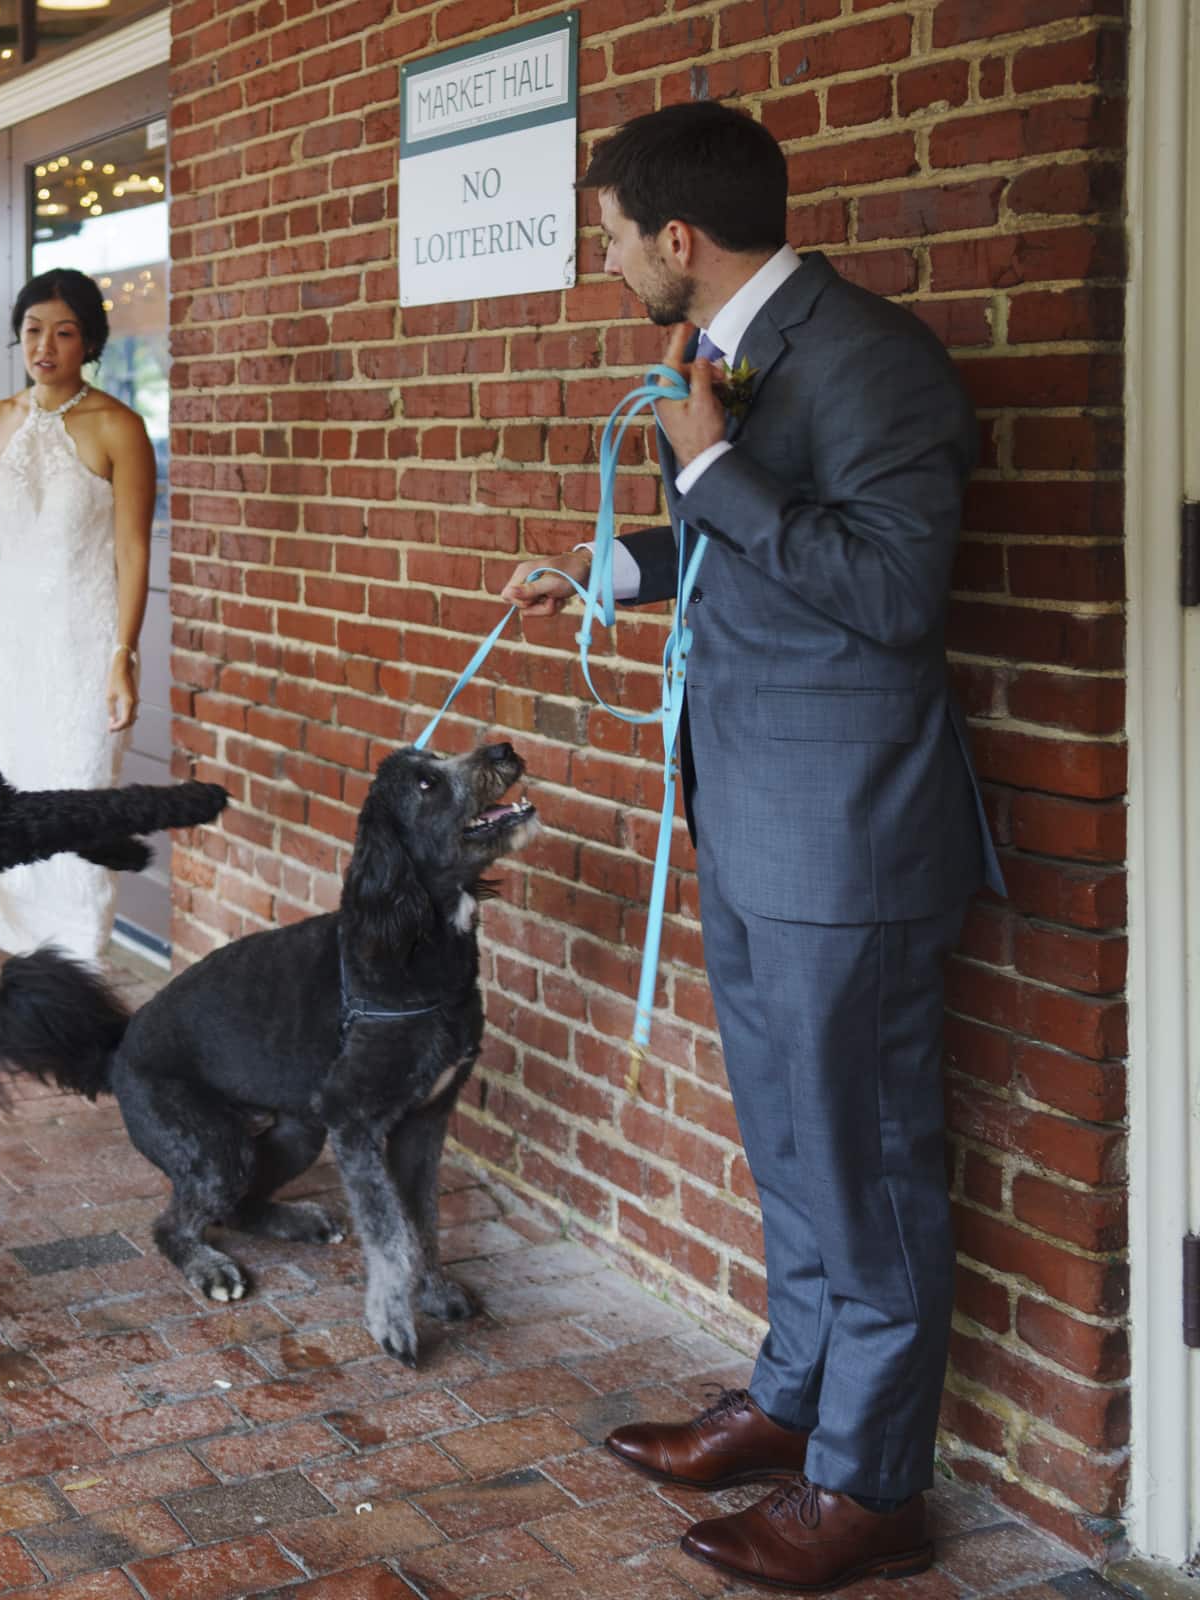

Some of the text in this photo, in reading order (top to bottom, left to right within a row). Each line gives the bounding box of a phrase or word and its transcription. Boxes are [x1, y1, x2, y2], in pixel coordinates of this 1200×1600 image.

[417, 53, 554, 123] MARKET HALL
[461, 167, 502, 204] NO
[415, 213, 558, 266] LOITERING
